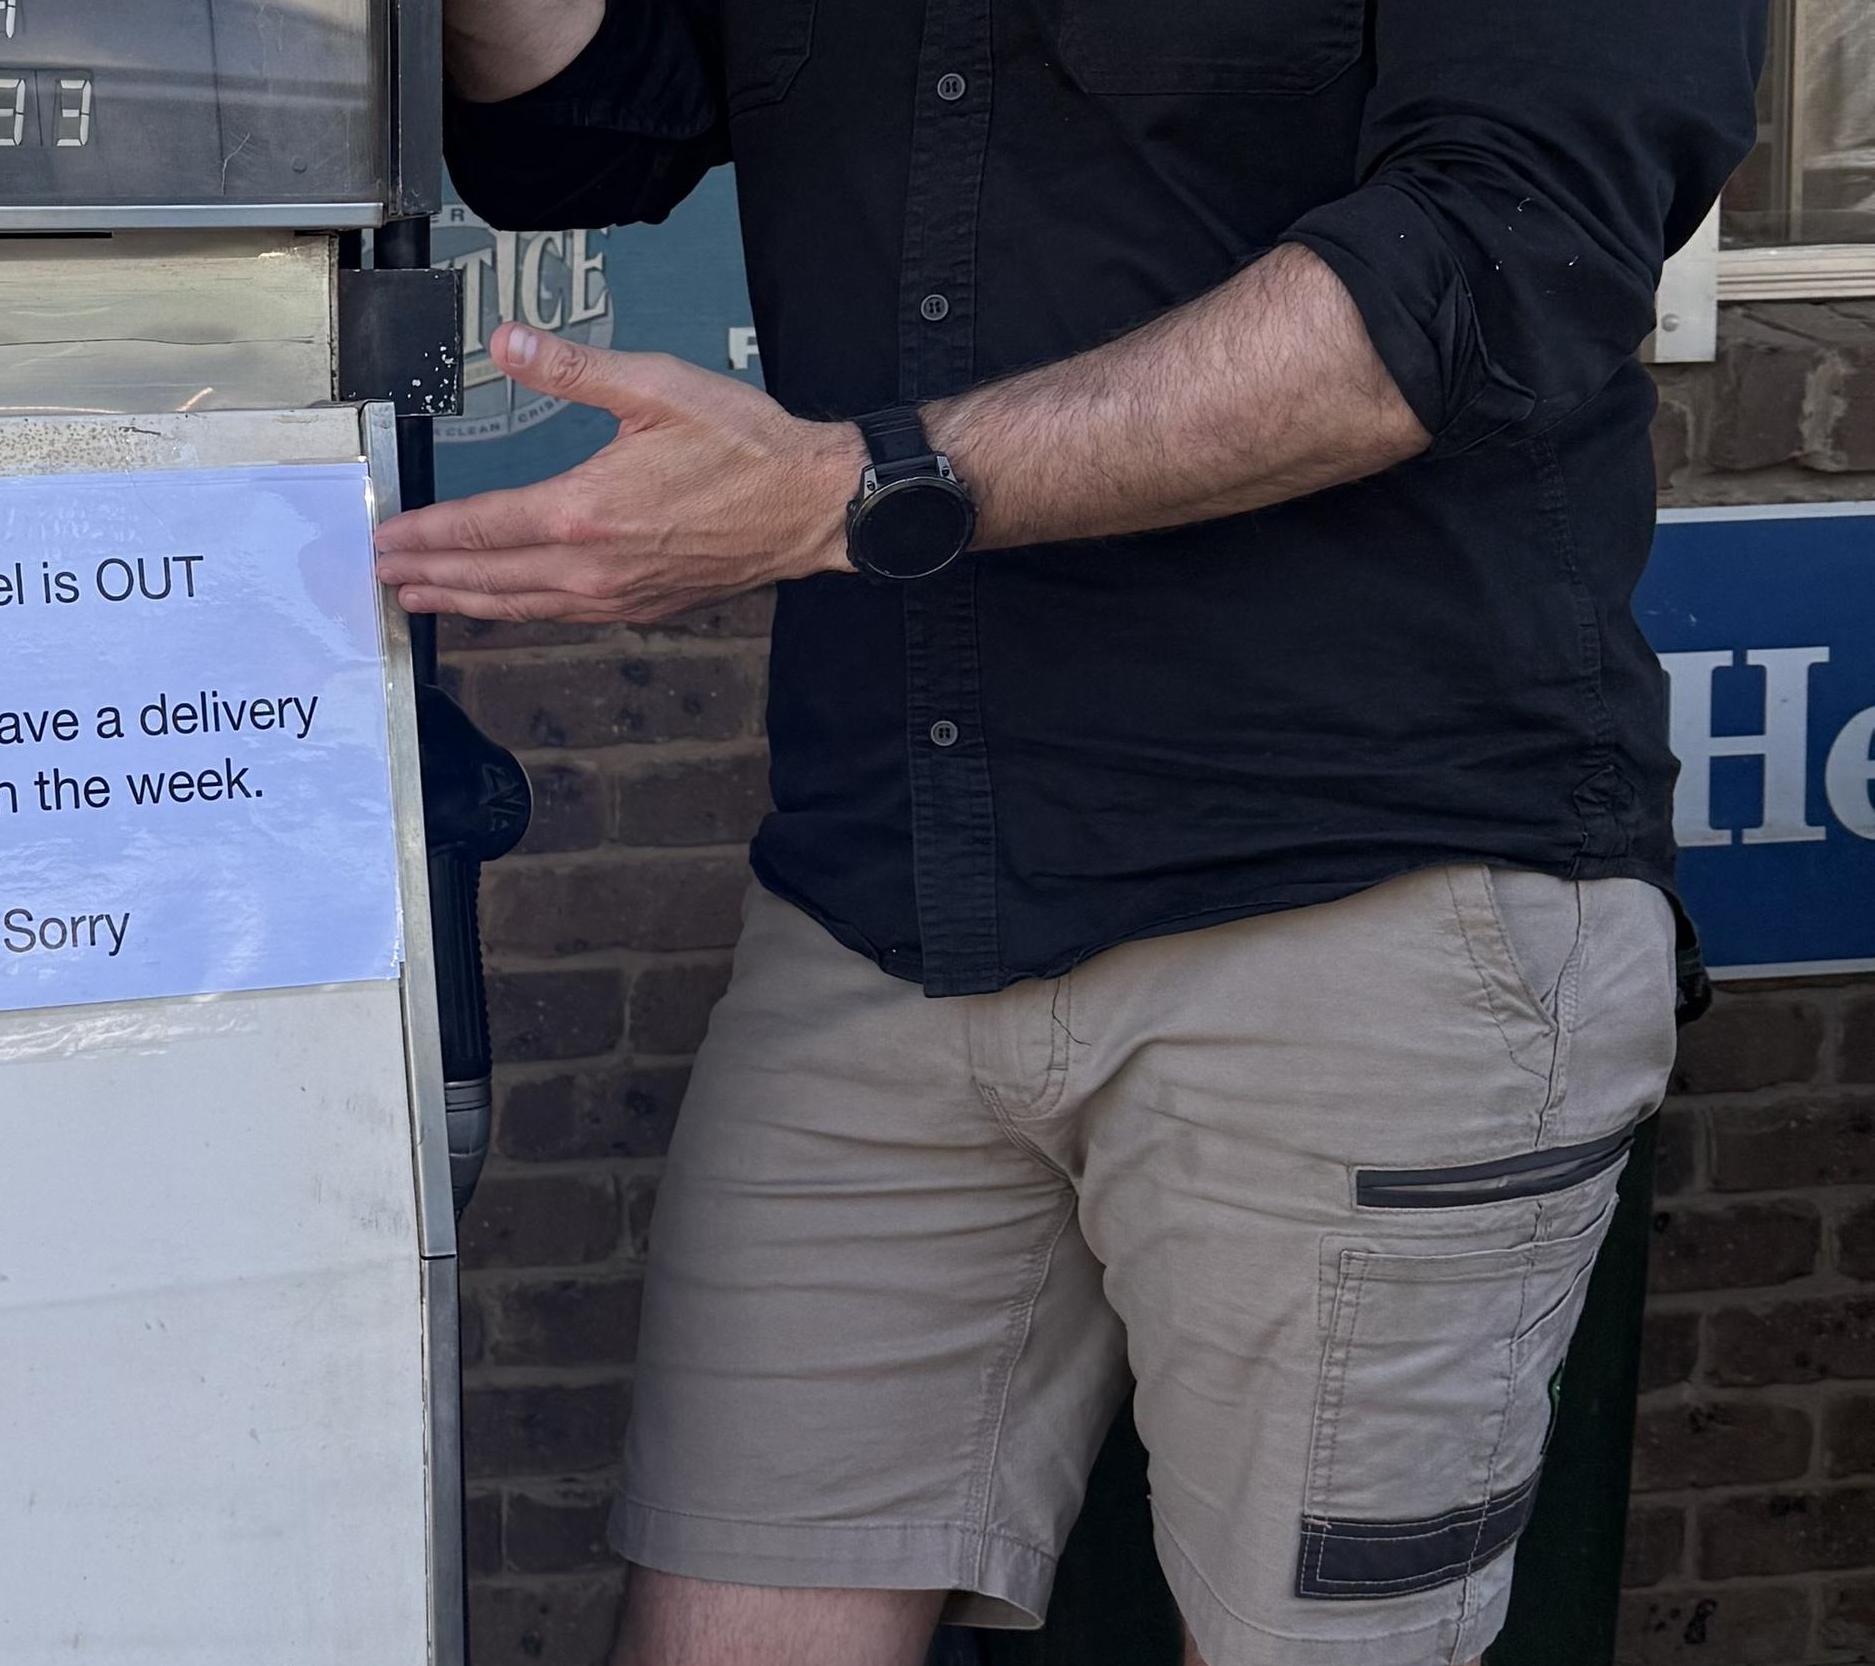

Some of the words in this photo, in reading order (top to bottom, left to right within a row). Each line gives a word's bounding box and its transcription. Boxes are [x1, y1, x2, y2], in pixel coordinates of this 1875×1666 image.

[43, 561, 79, 604] is
[96, 555, 204, 601] OUT
[97, 707, 124, 738] a
[140, 691, 318, 739] delivery
[34, 768, 110, 811] the
[126, 758, 263, 805] week.
[4, 909, 130, 956] Sorry
